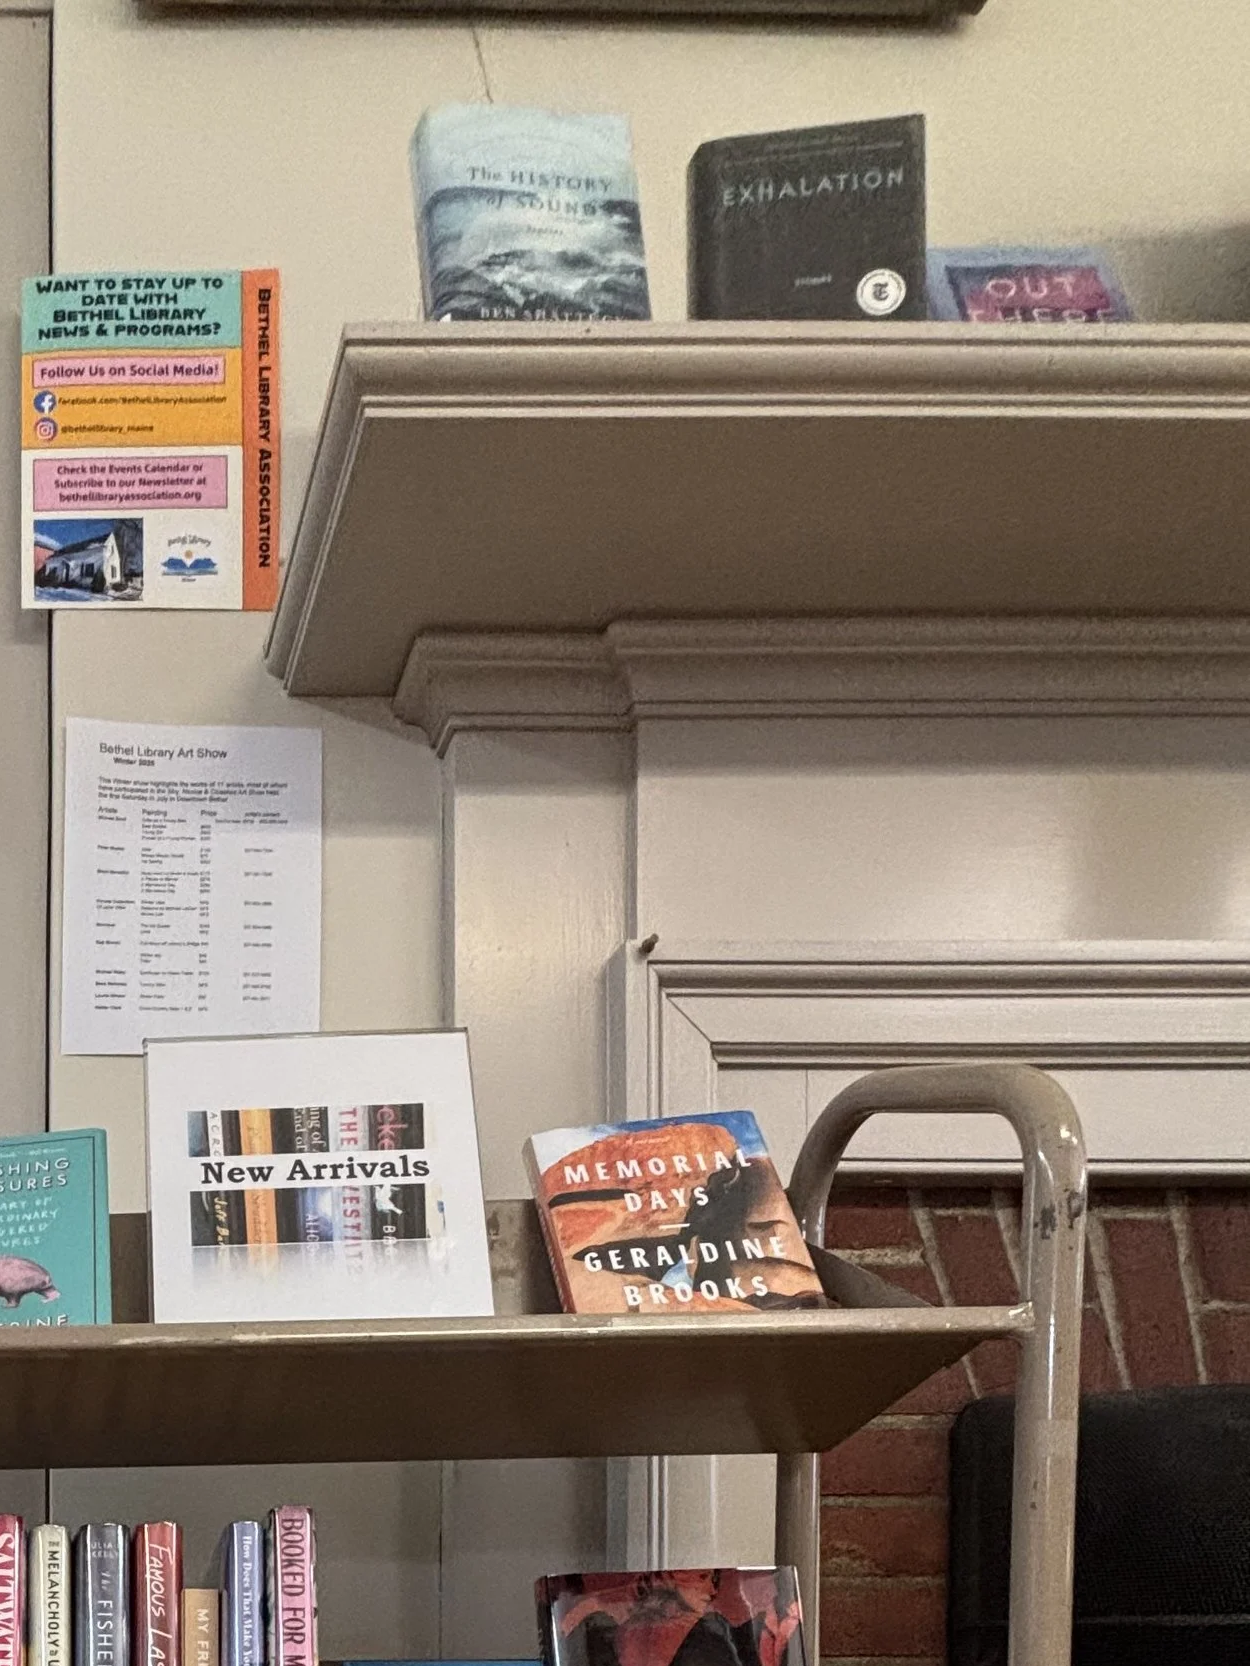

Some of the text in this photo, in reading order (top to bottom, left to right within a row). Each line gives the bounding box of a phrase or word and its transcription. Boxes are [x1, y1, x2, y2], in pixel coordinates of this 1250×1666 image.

[468, 167, 612, 191] The HISTORY
[723, 168, 904, 207] EXHALATION
[36, 277, 224, 293] WANT TO STAY UP TO
[986, 276, 1077, 299] OUT
[82, 292, 178, 306] DATE WITH
[53, 307, 206, 323] BETHEL LIBRARY
[38, 322, 222, 340] NEWS PROGRAMS?
[40, 363, 219, 379] Follow Us on Social Media!
[258, 288, 272, 568] BETHEL LIBRARY ASSOCIATION
[57, 463, 190, 475] Check Events Calendar
[54, 477, 193, 489] Subscribe Newsletter
[99, 742, 227, 760] Bethel Library Show
[338, 1107, 358, 1146] THE
[200, 1154, 430, 1184] New Arrivals
[564, 1149, 752, 1185] MEMORIAL
[624, 1187, 709, 1213] DAYS
[584, 1235, 789, 1273] GERALDINE
[624, 1275, 769, 1307] BROOKS
[281, 1517, 305, 1597] BOOKED
[149, 1543, 174, 1617] FAMOUS
[47, 1550, 61, 1648] MELANCHOLY
[197, 1608, 209, 1634] MY
[282, 1607, 306, 1644] FOR
